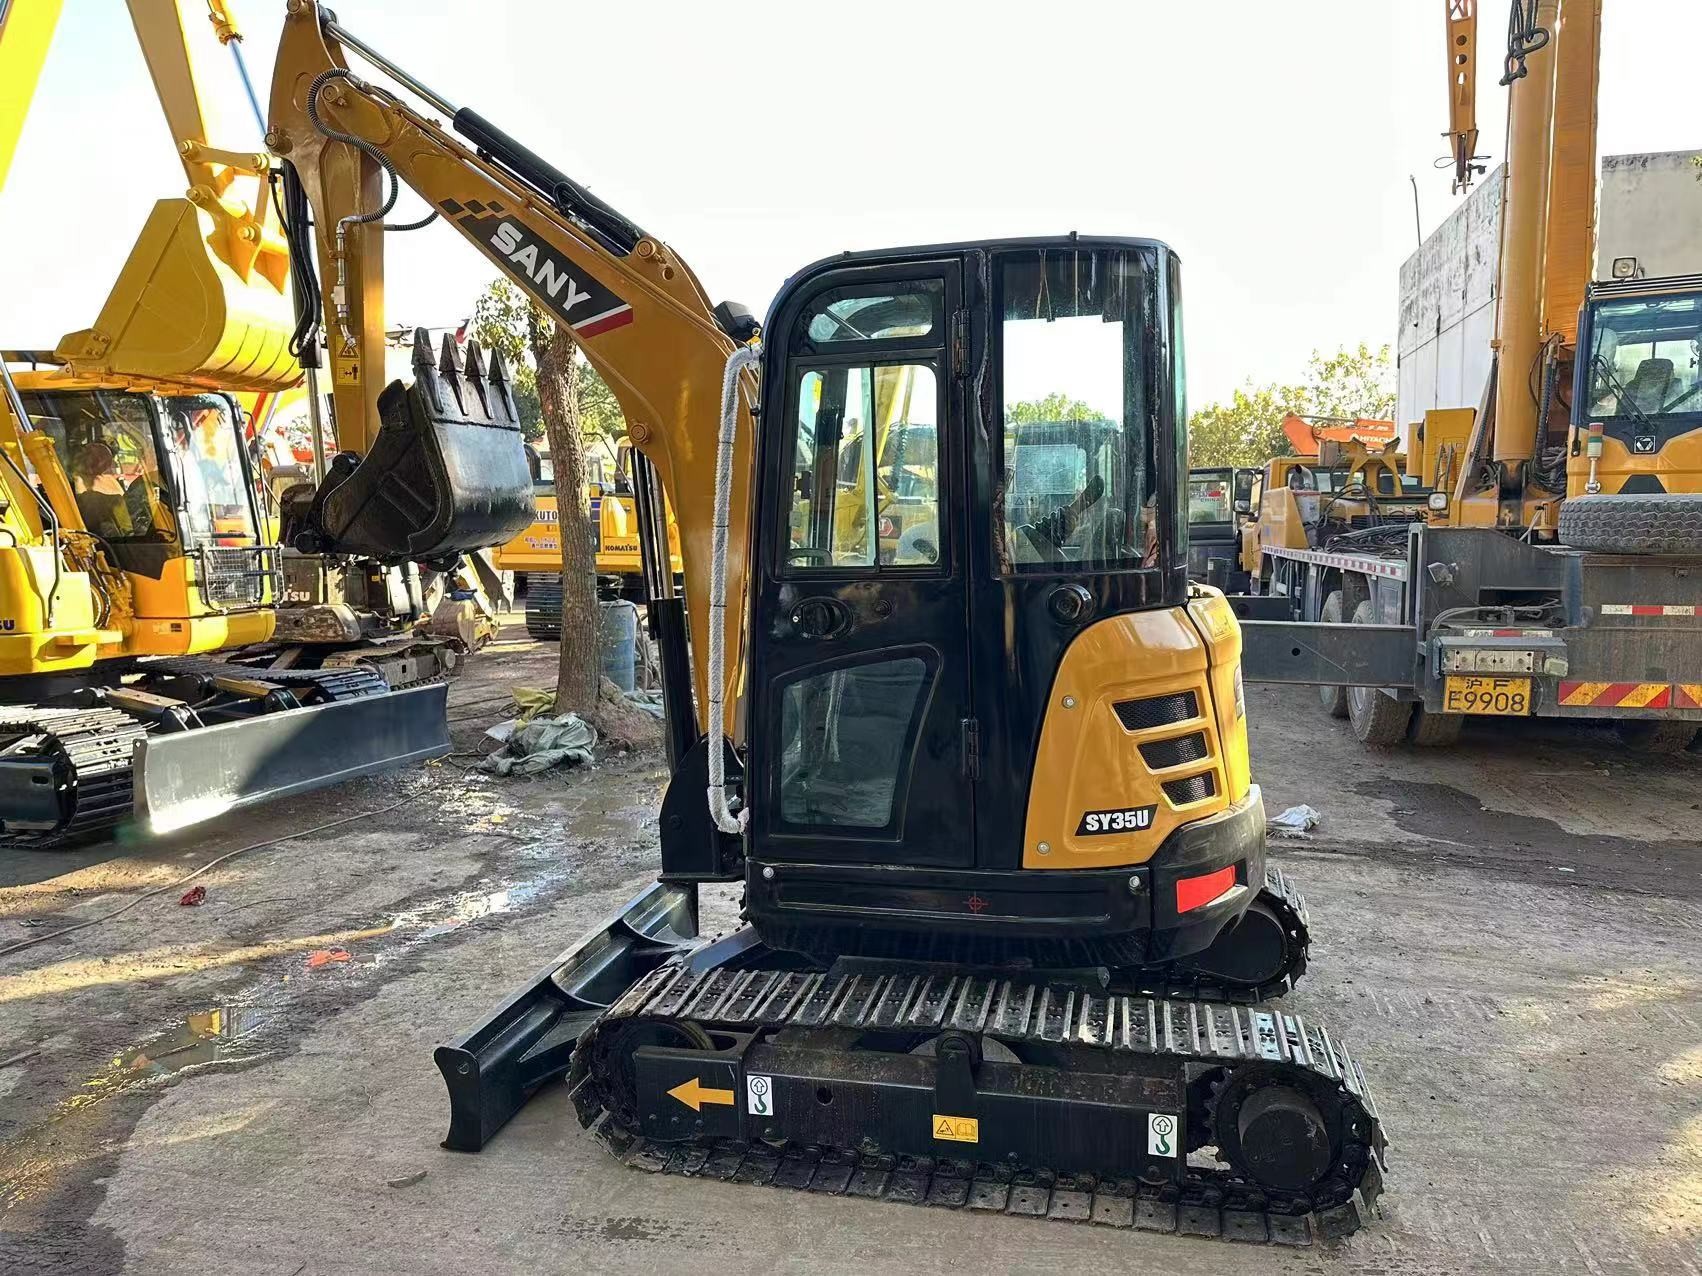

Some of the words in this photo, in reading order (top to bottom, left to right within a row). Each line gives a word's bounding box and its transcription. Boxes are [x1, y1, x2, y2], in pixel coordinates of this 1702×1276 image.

[490, 222, 592, 311] SANY
[1447, 690, 1525, 713] E9908
[1085, 809, 1149, 831] SY35U
